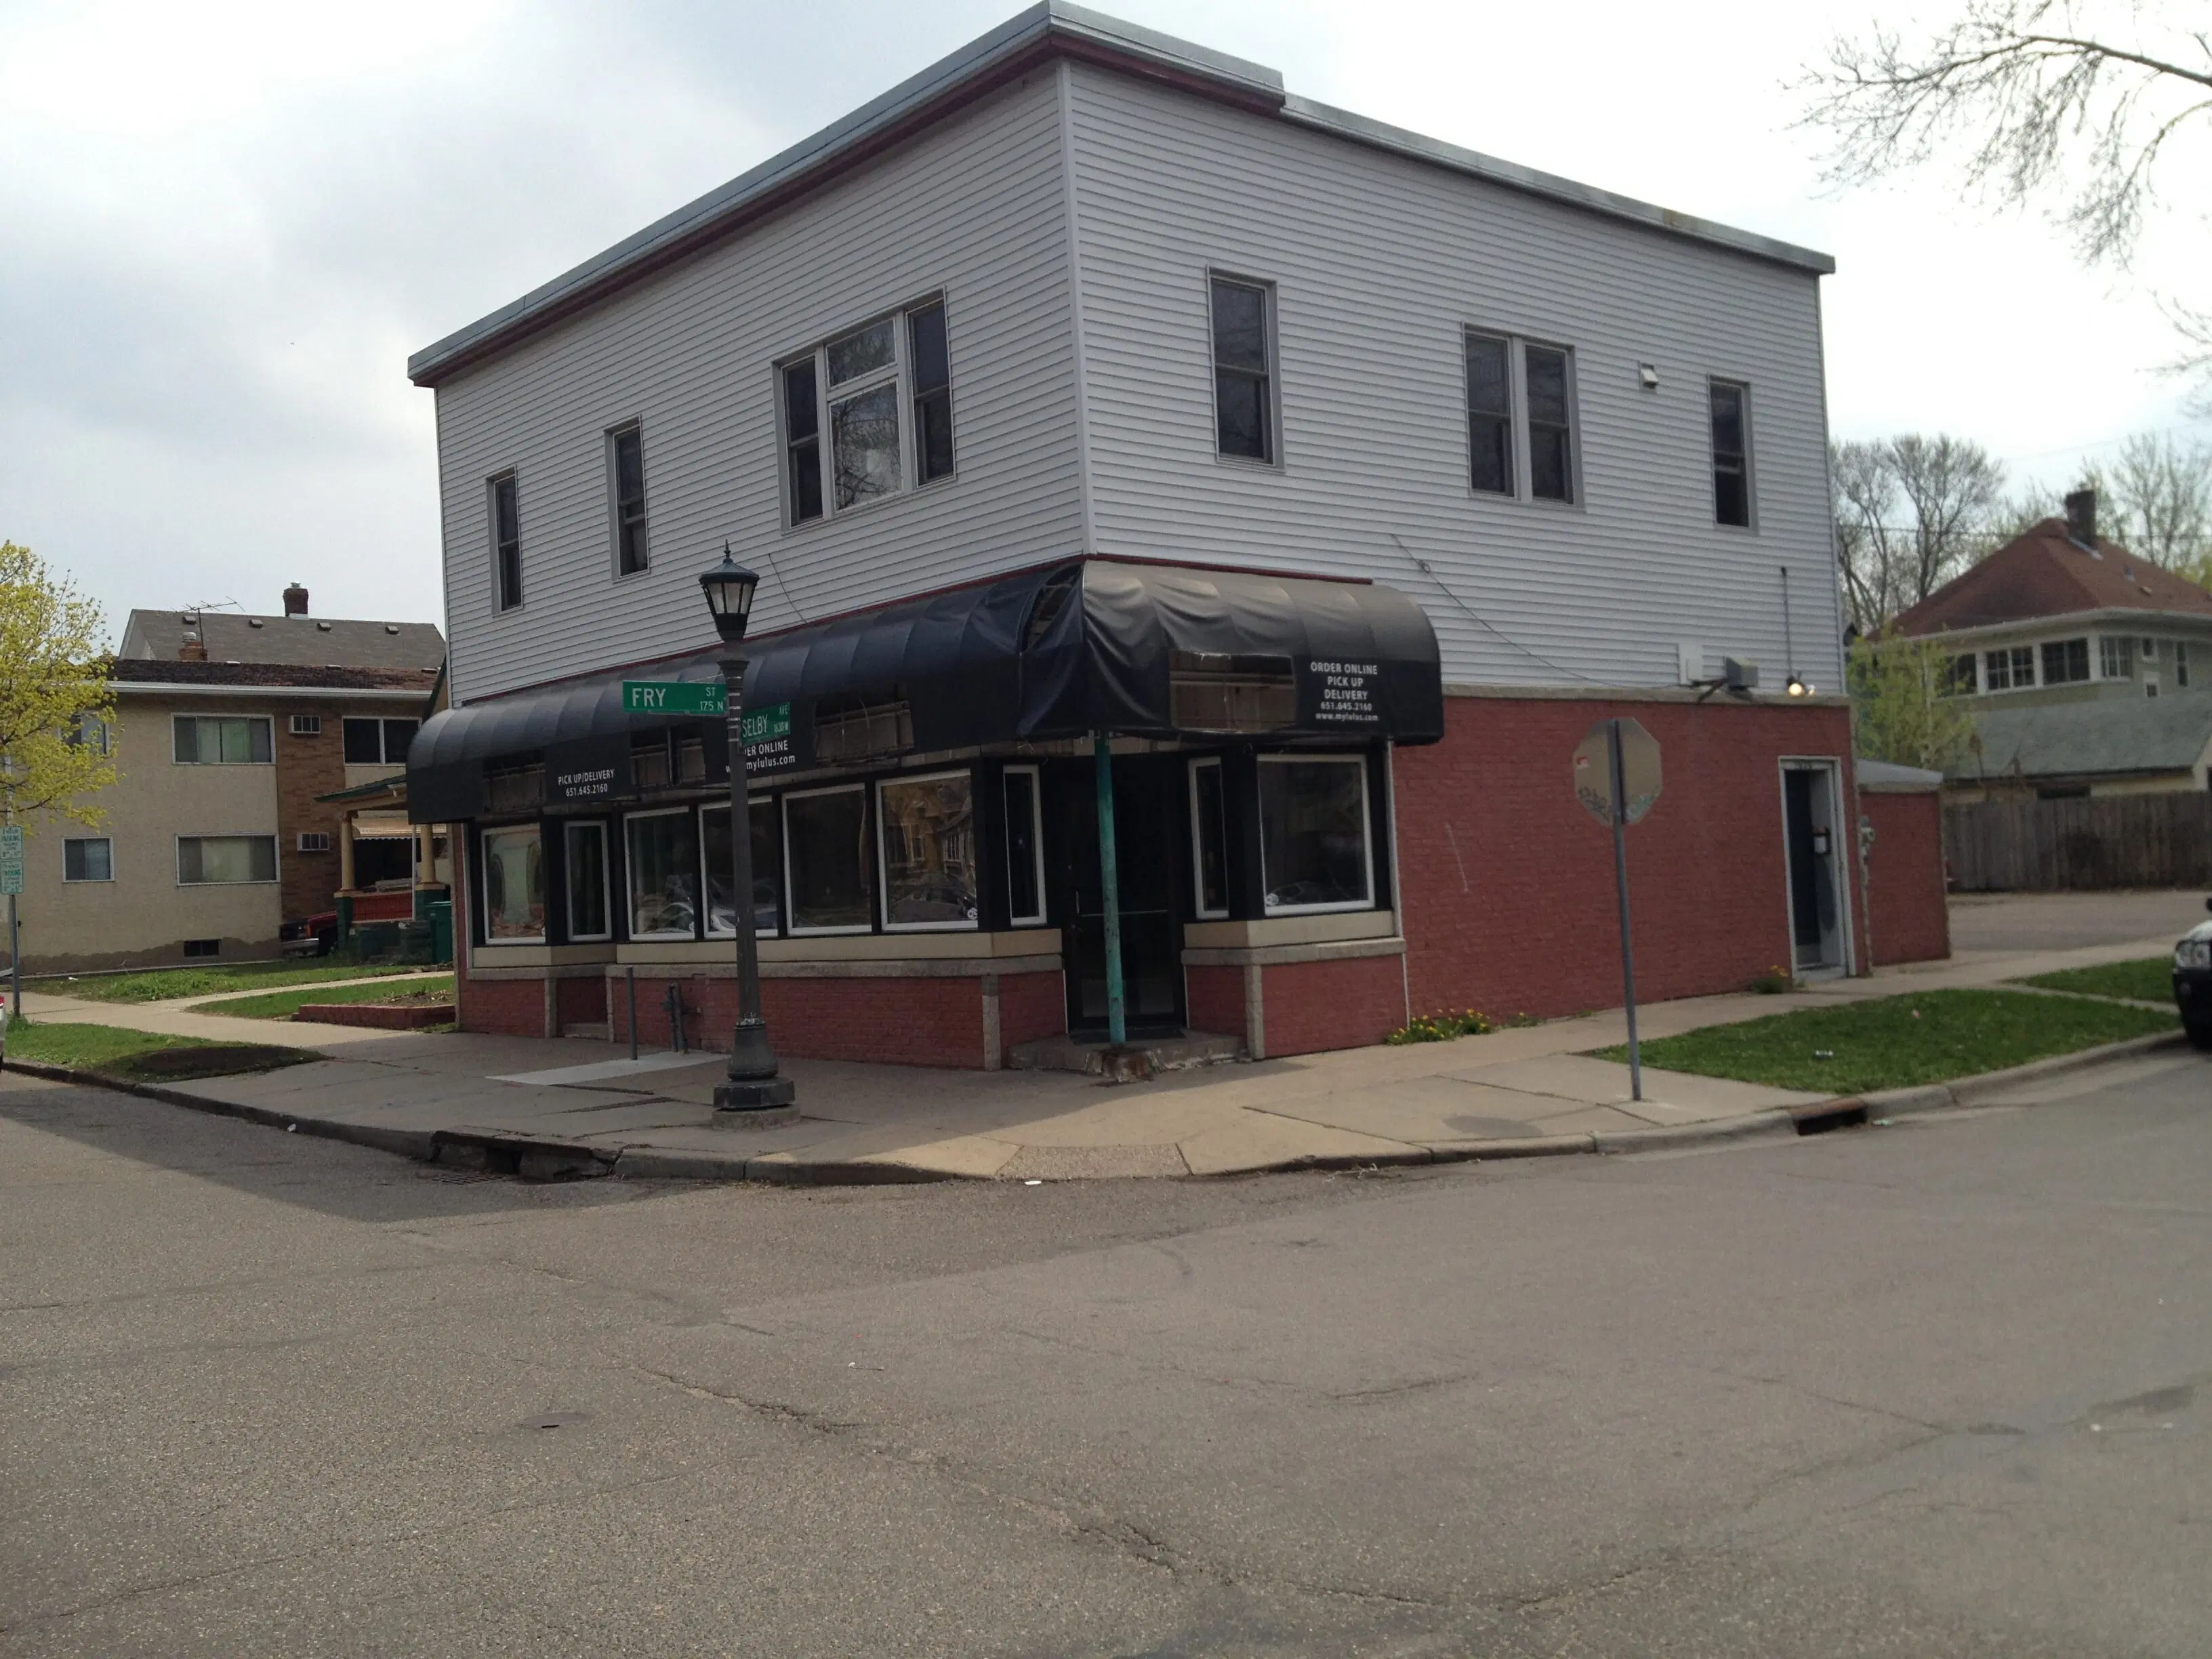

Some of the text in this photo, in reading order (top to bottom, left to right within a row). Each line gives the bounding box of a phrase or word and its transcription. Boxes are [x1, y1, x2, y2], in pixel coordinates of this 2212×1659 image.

[1311, 661, 1378, 675] ORDER ONLINE
[1328, 676, 1364, 687] PICK UP
[632, 687, 716, 707] FRY ST
[1324, 689, 1368, 700] DELIVERY
[700, 701, 724, 711] 175 N
[1320, 701, 1372, 711] 651.645.2160
[1315, 712, 1378, 722] www.mylulus.com
[742, 714, 768, 738] SELBY
[758, 740, 789, 754] ONLINE
[558, 769, 614, 785] PICK UP/DELIVERY
[566, 783, 608, 797] 651.645.2160
